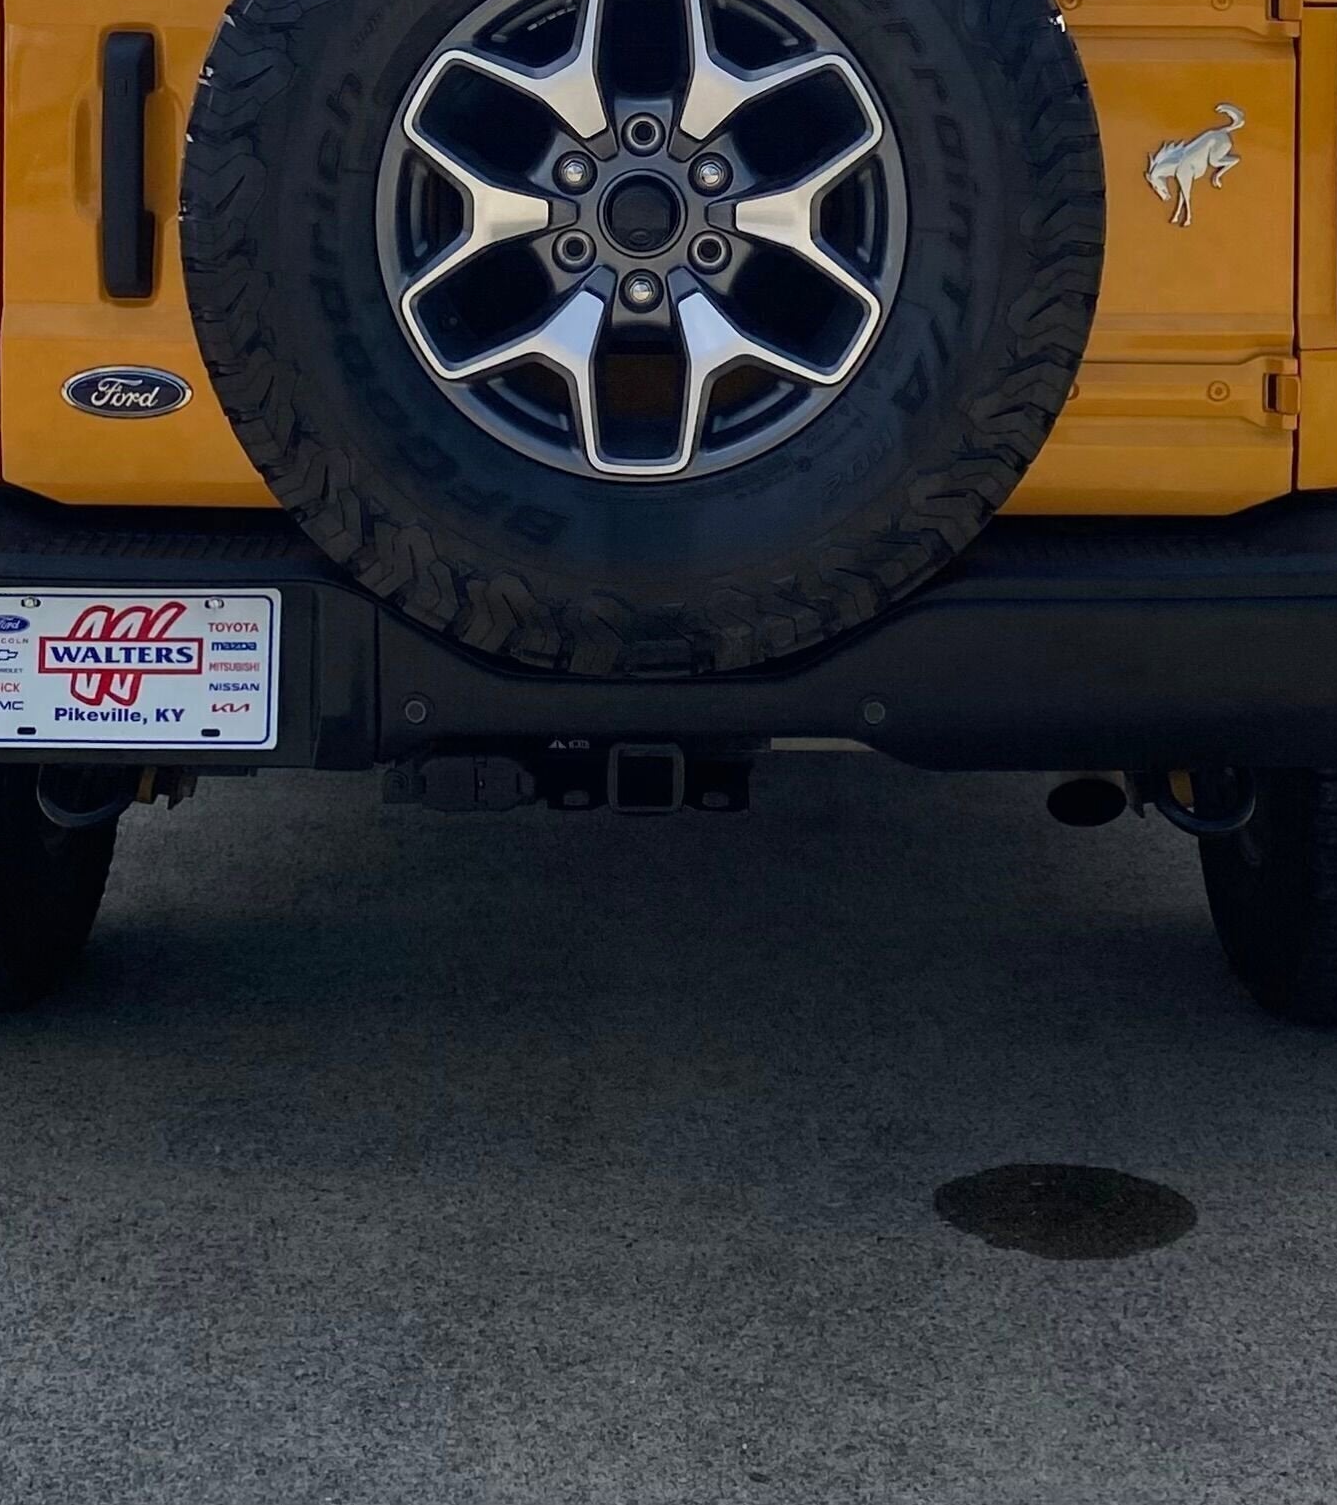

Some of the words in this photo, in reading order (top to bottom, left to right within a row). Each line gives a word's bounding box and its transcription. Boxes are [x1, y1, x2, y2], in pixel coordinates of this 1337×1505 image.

[90, 377, 161, 408] Ford
[207, 622, 260, 633] TOYOTA
[49, 645, 194, 665] WALTERS
[208, 661, 261, 672] MITSUBISHI
[208, 682, 261, 692] NISSAN
[54, 707, 148, 725] Pikeville,
[154, 707, 185, 723] KY
